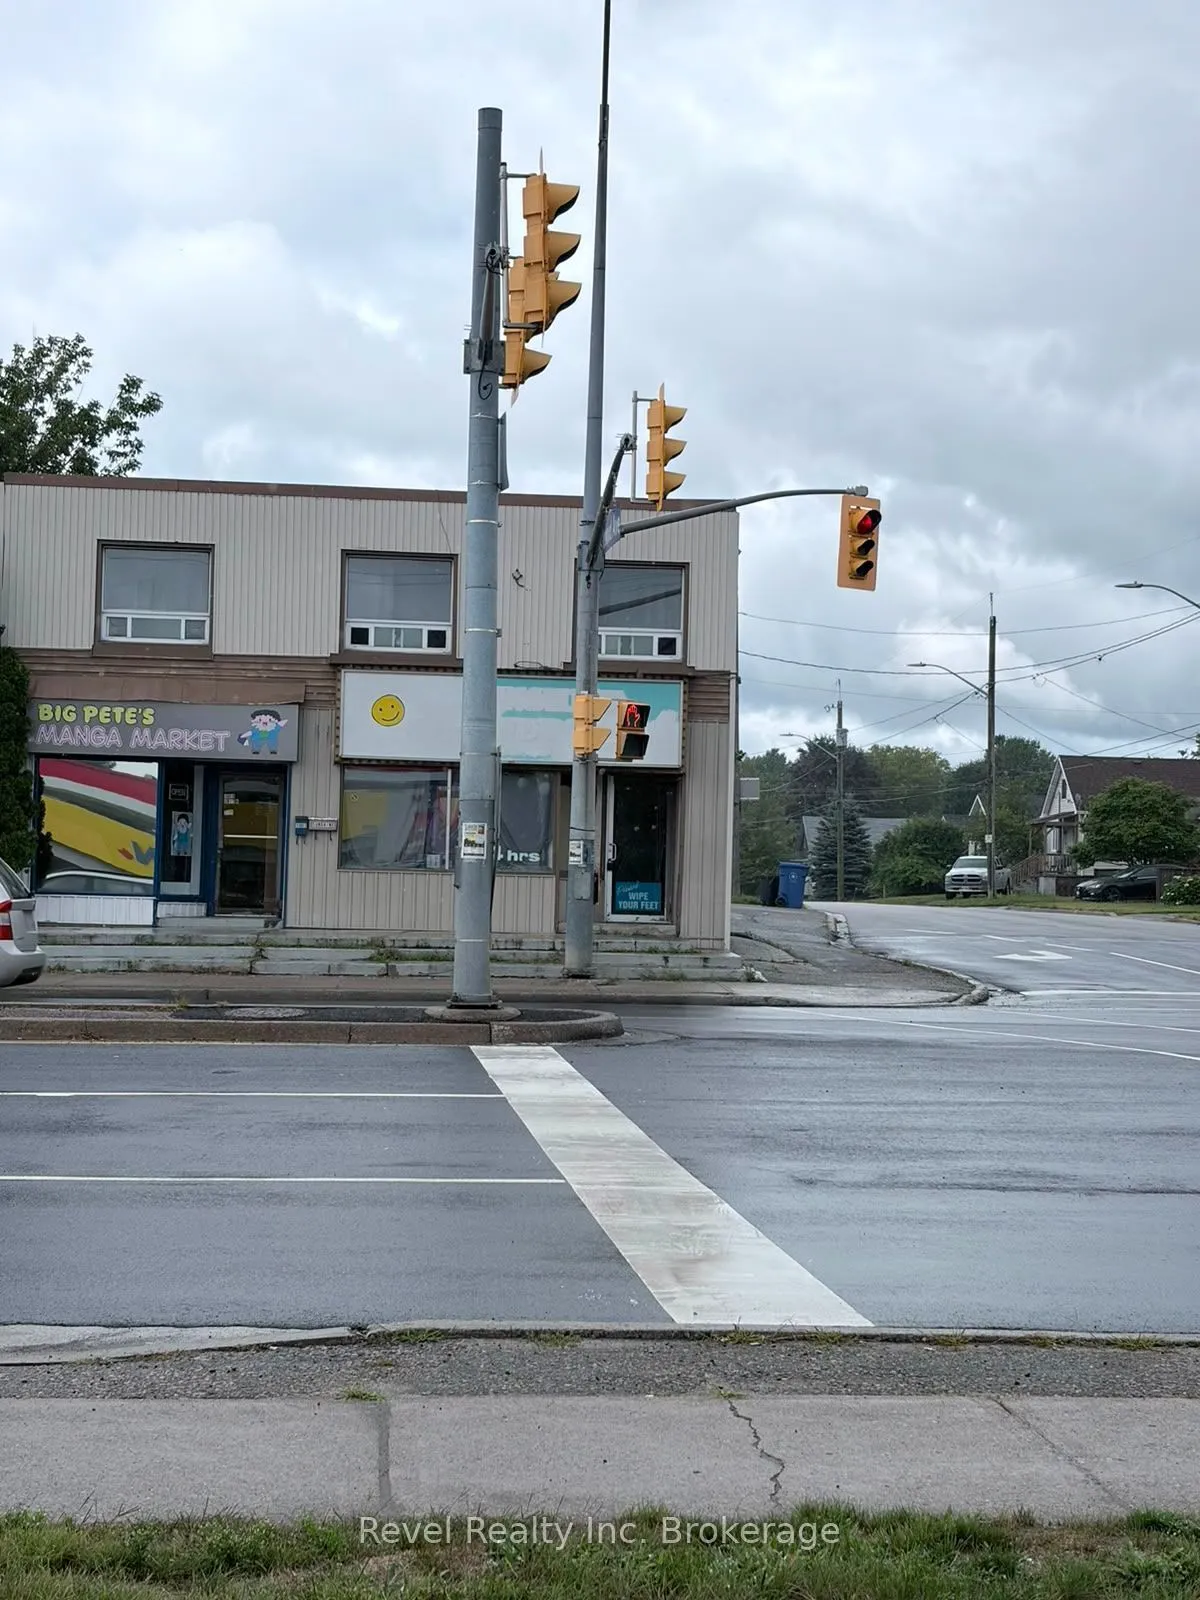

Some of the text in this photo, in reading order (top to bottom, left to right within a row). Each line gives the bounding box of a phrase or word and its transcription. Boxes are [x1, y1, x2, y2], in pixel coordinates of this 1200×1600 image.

[37, 703, 155, 726] BIG PETE'S
[36, 724, 231, 752] MANGA MARKET
[507, 849, 541, 862] hrs
[628, 892, 649, 901] WIPE
[618, 901, 659, 910] YOUR FEET
